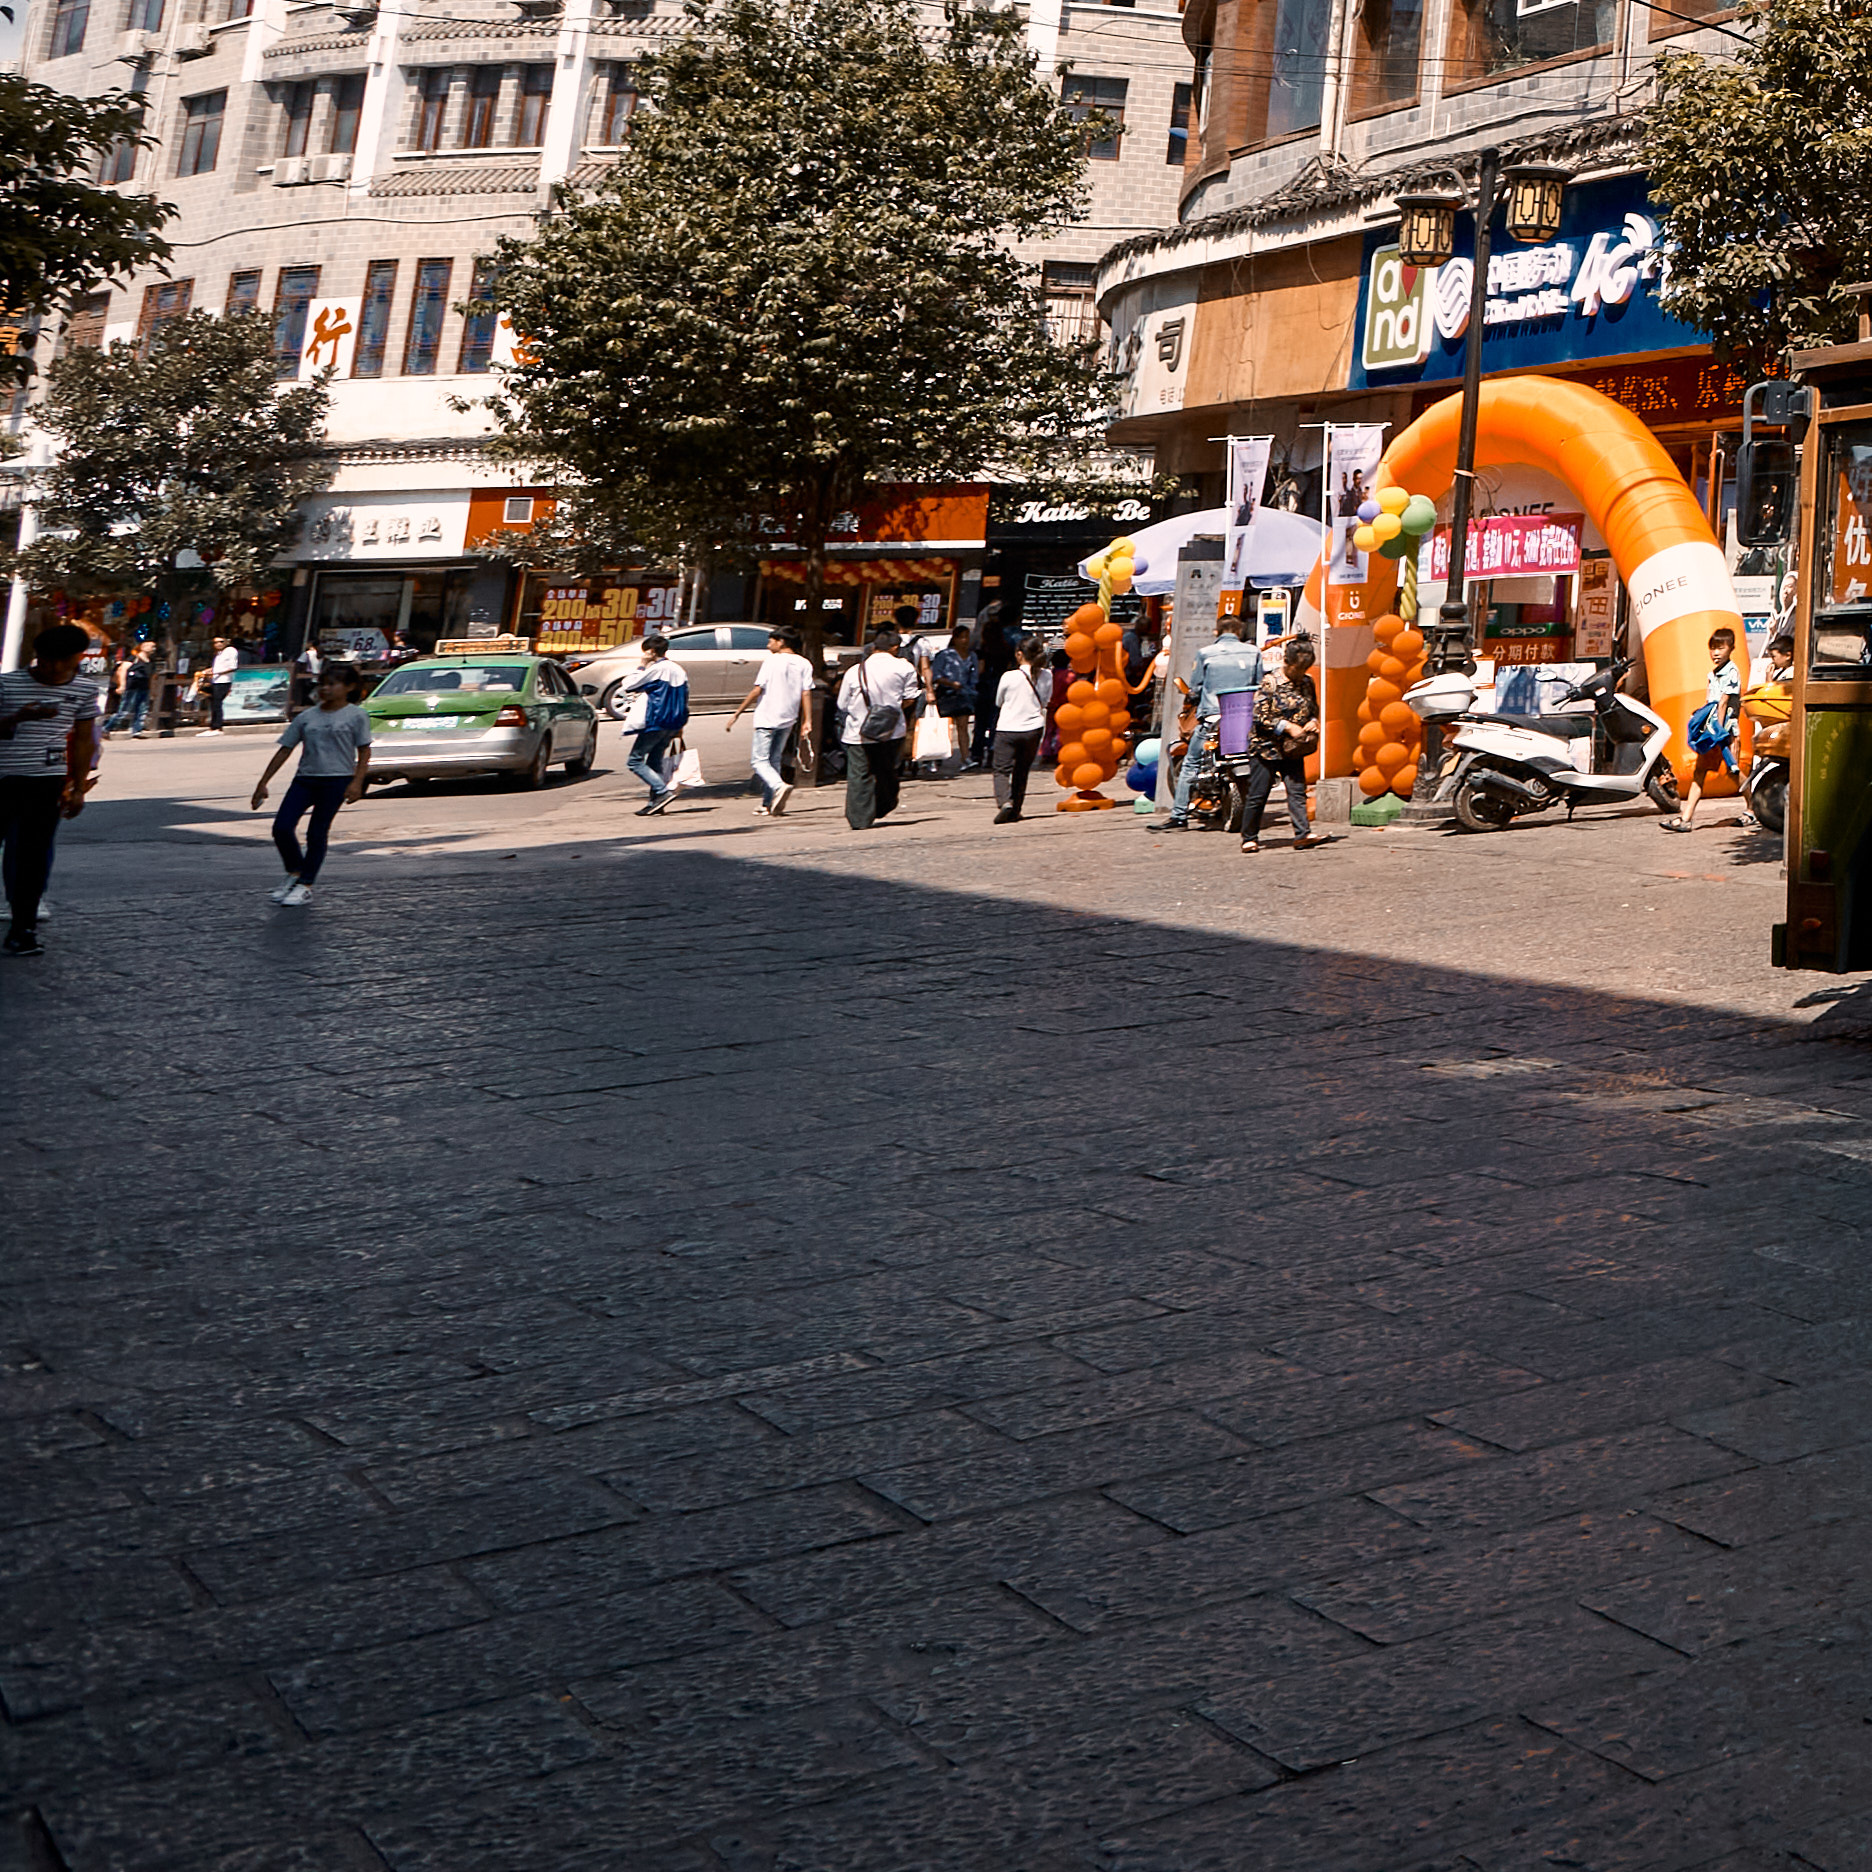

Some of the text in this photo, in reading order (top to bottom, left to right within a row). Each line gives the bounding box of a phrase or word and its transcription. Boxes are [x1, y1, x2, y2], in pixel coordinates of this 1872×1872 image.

[1487, 243, 1574, 295] 中国移动
[305, 305, 352, 367] 行
[1016, 501, 1089, 524] Katie
[542, 599, 587, 620] 200
[601, 588, 639, 619] 30
[1492, 644, 1556, 661] 分期付款
